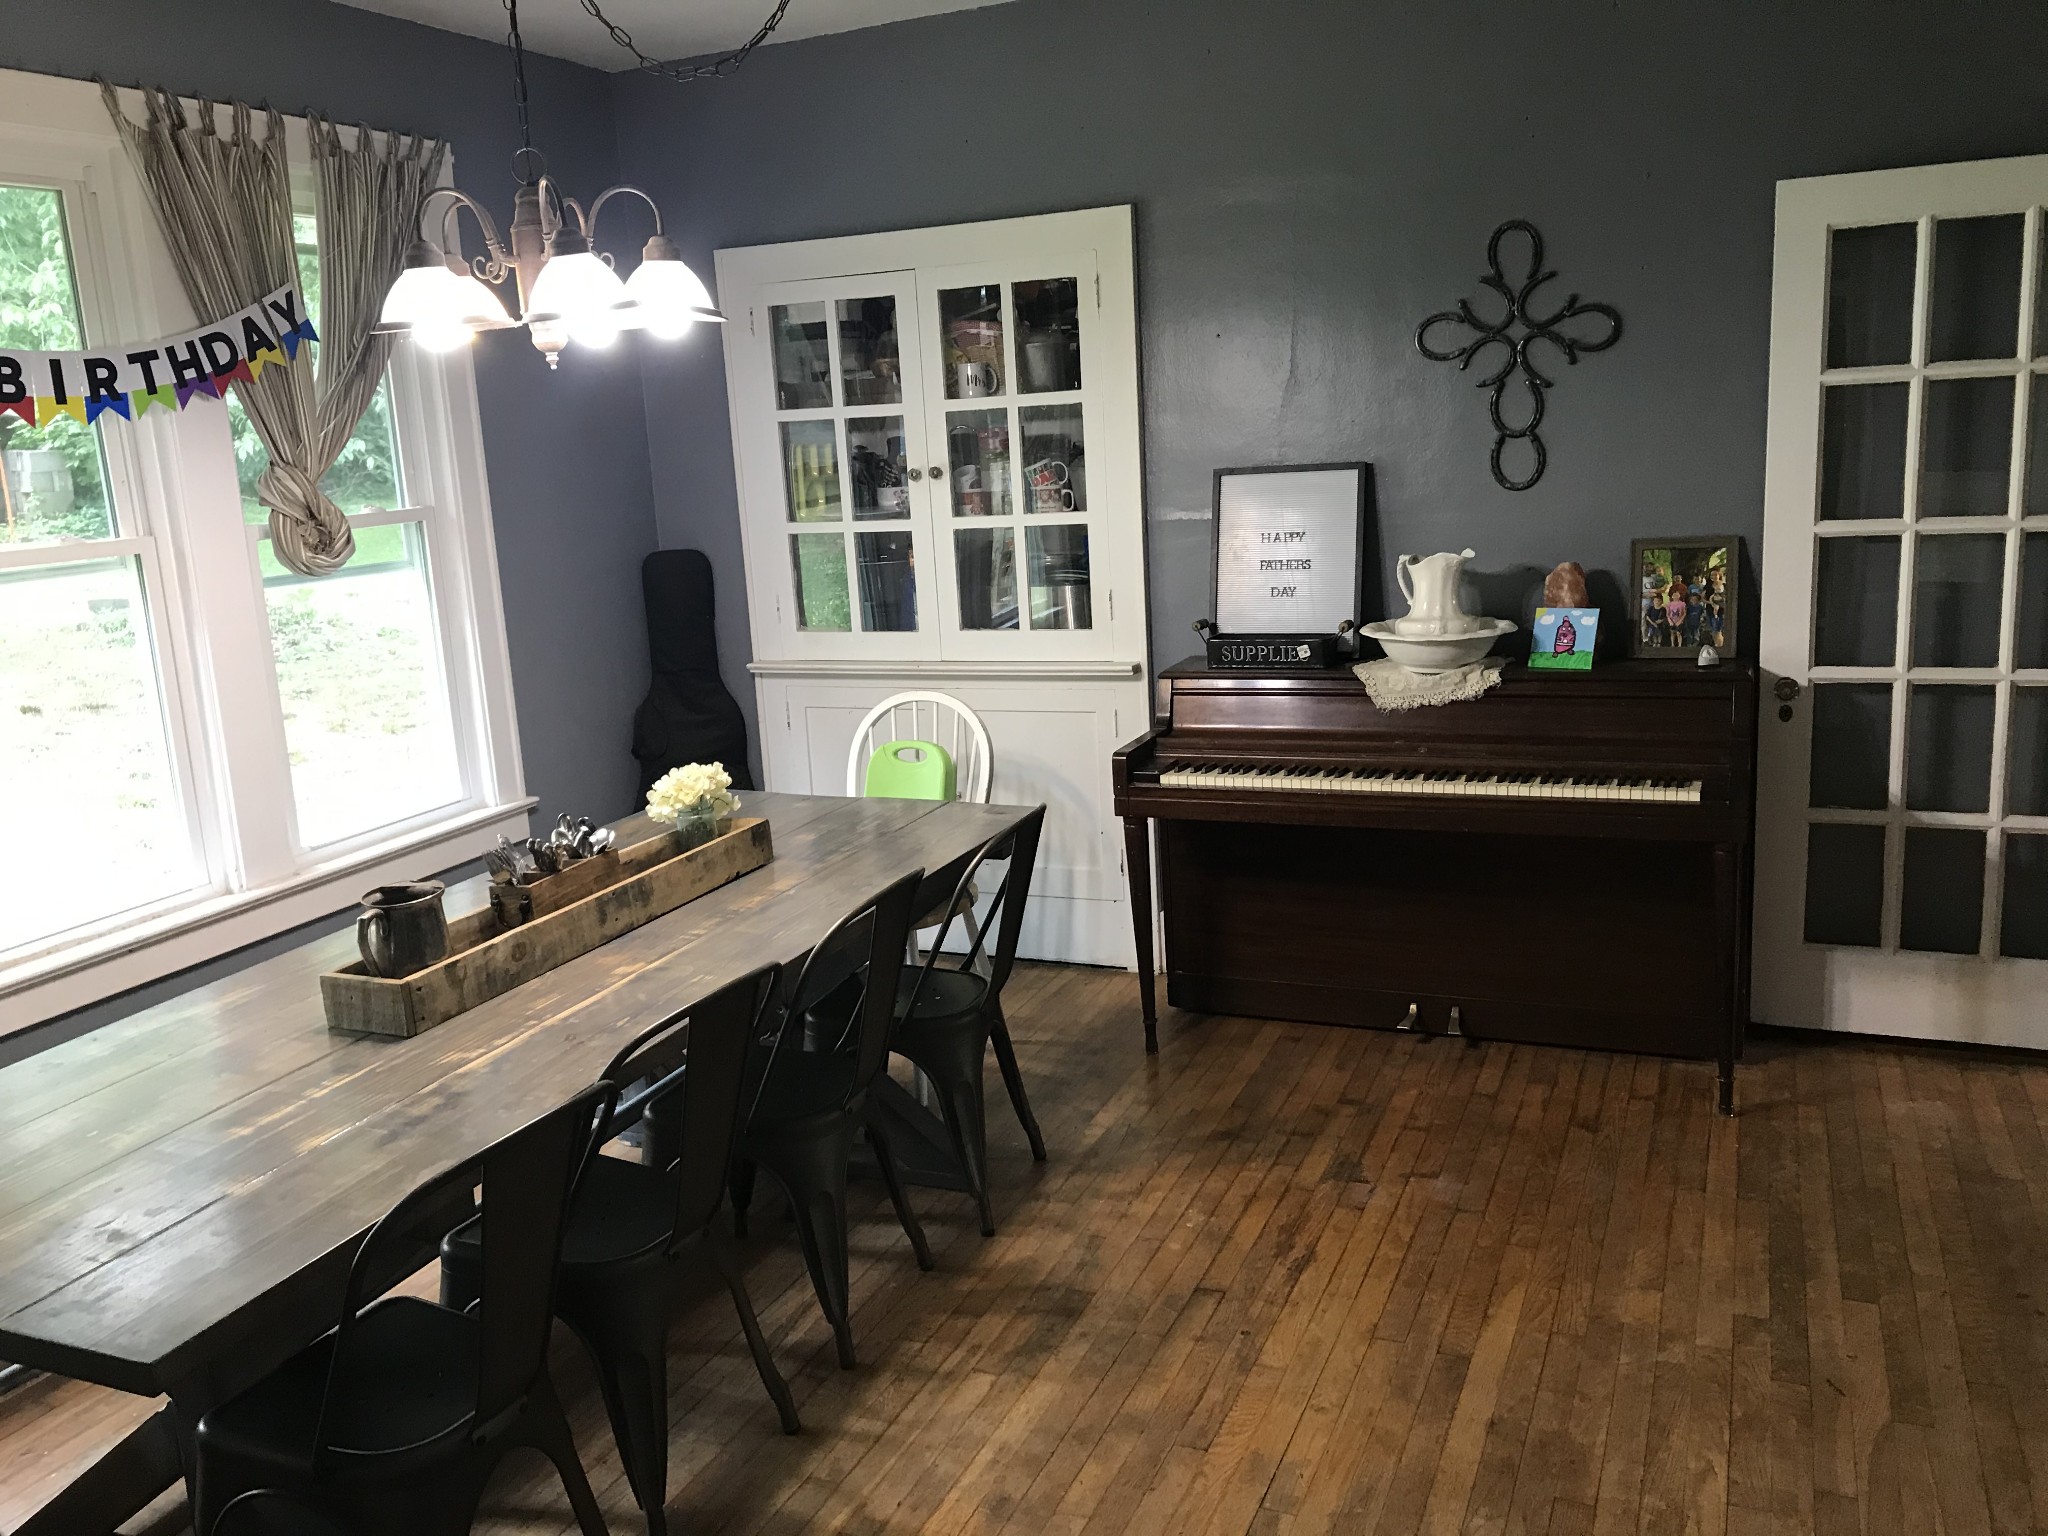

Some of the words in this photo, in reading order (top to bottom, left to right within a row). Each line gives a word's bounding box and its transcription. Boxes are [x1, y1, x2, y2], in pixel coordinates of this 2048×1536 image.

[0, 289, 300, 405] BIRTHDAY
[1261, 532, 1305, 543] HAPPY
[1259, 559, 1311, 570] FATHERS
[1271, 587, 1296, 597] DAY
